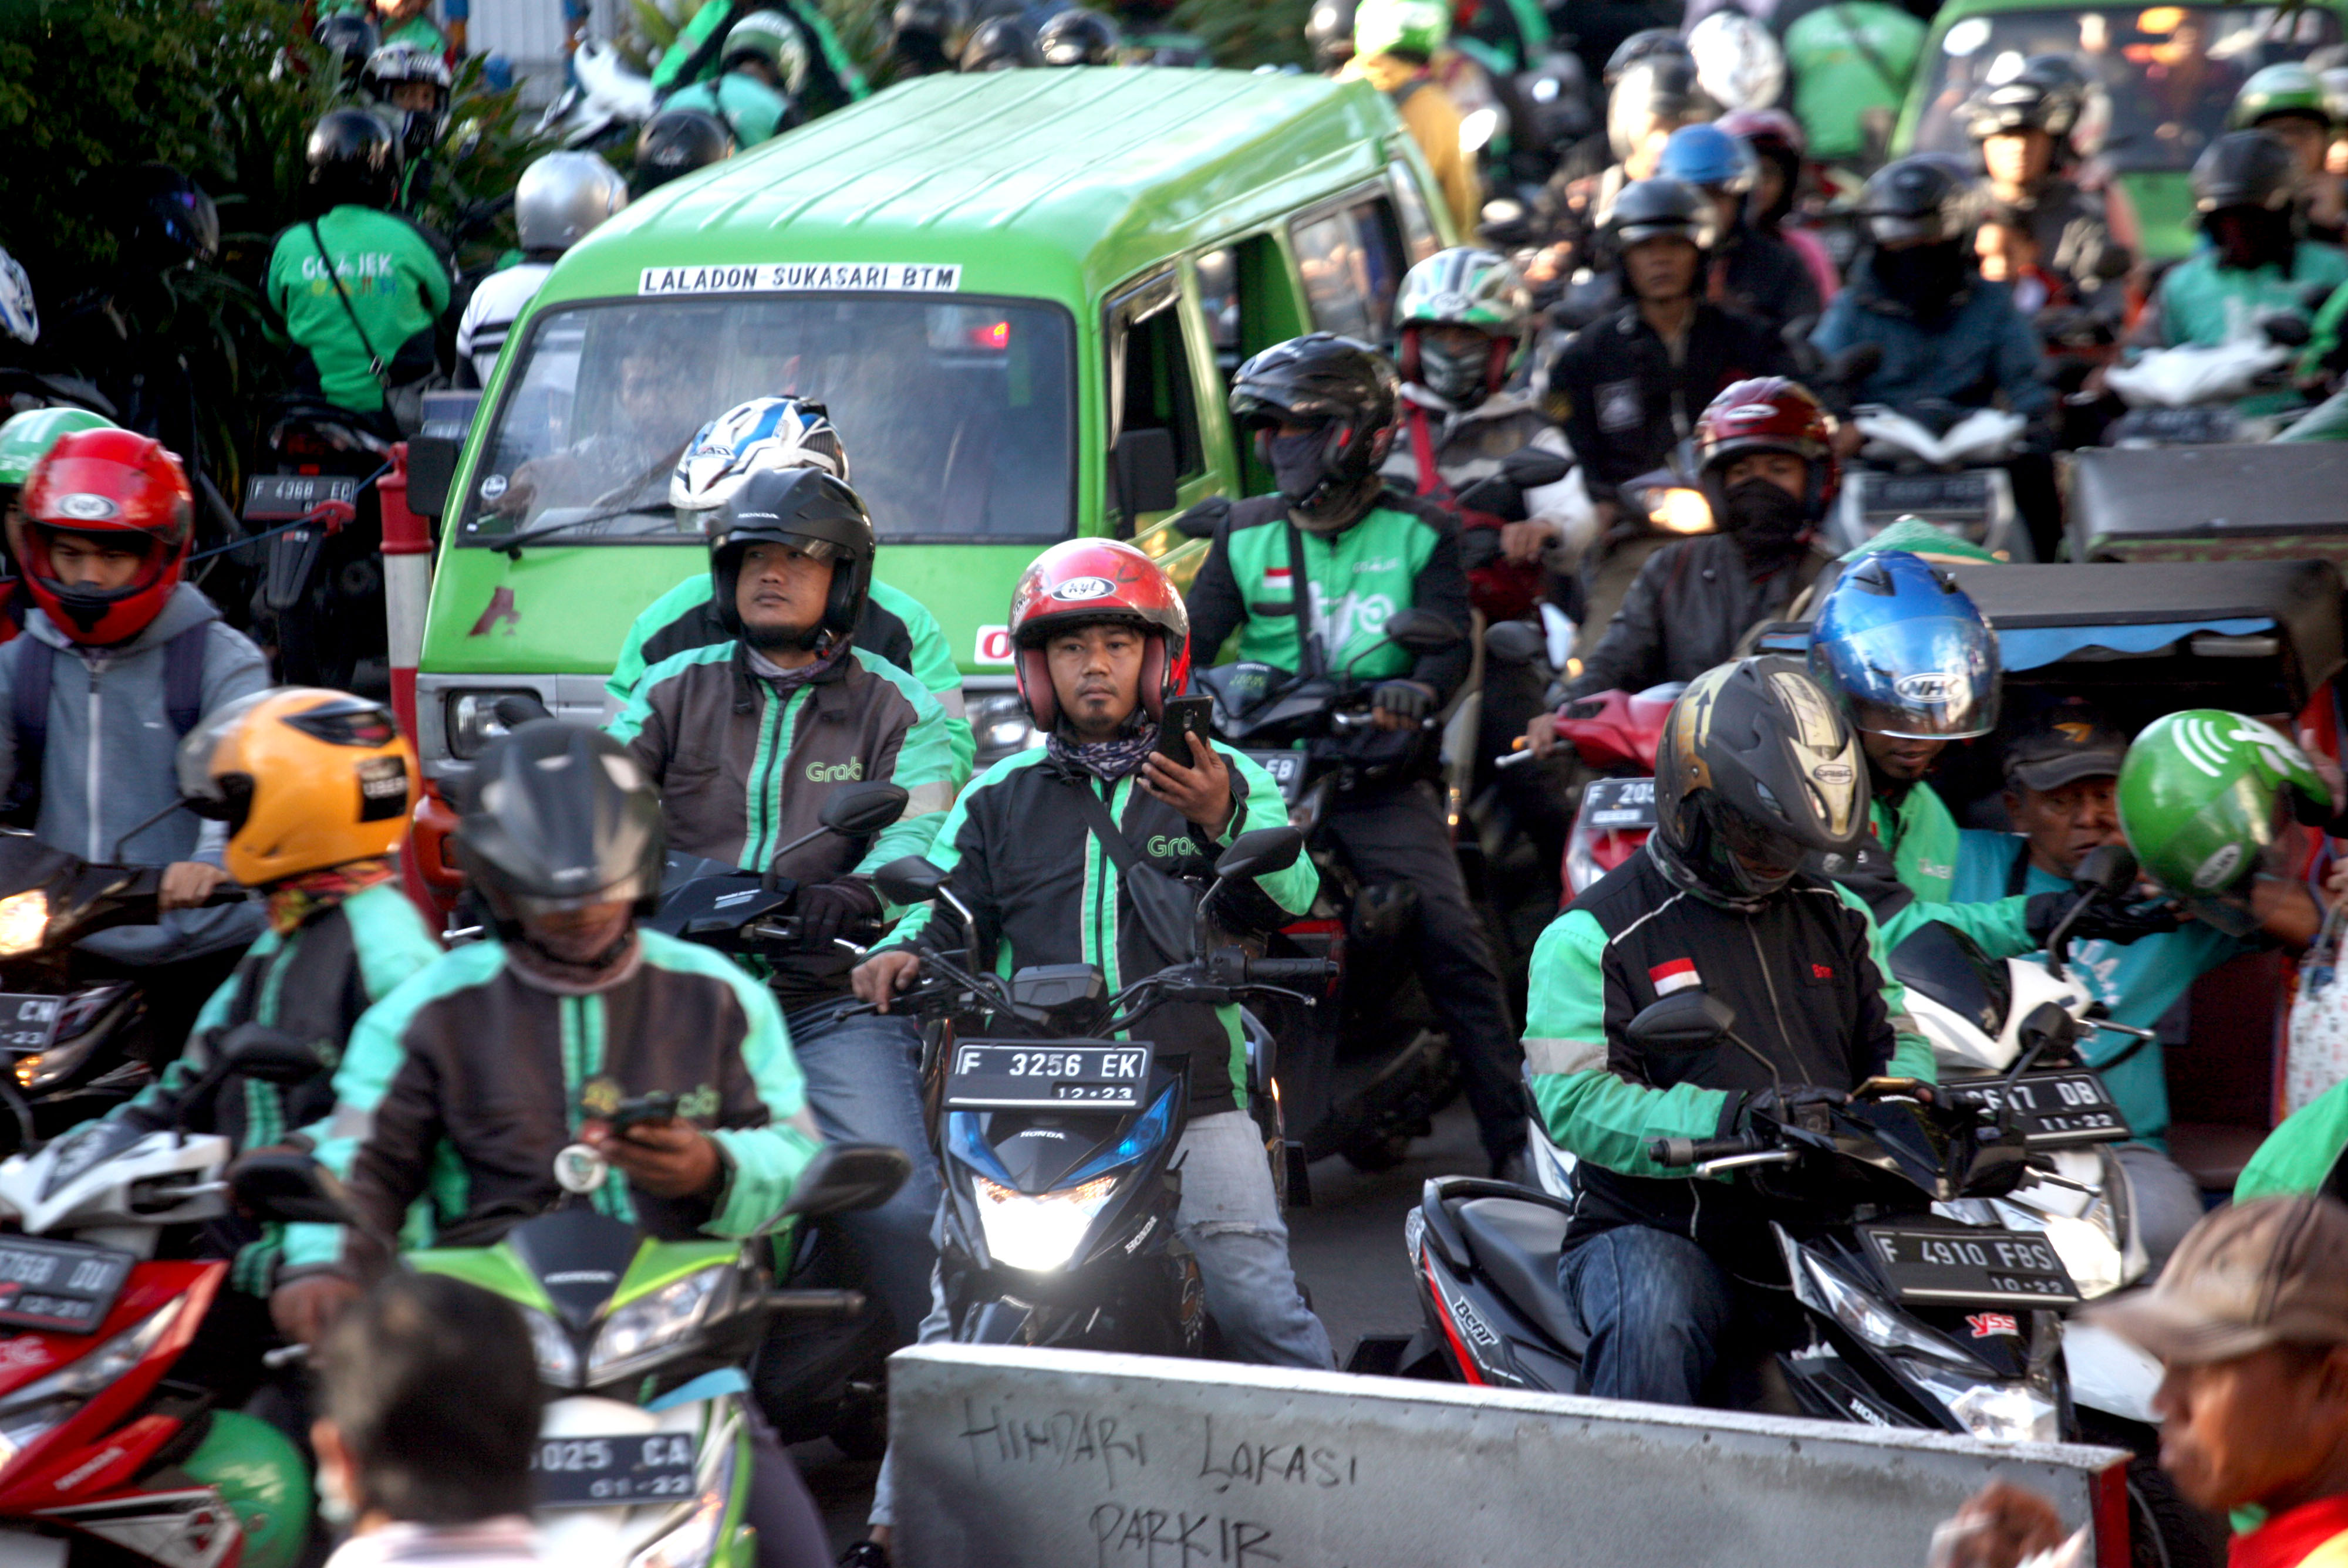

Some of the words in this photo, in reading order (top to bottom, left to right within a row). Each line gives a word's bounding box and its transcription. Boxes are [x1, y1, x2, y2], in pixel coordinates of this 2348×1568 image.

[645, 268, 757, 292] LALADON
[772, 266, 888, 288] SUKASARI
[902, 268, 954, 288] BTM
[255, 481, 264, 499] F
[805, 755, 862, 783] Grab
[1587, 785, 1605, 806] F
[960, 1052, 981, 1075] F
[1009, 1053, 1082, 1077] 3256
[1101, 1054, 1139, 1078] EK
[1020, 1130, 1066, 1140] HONDA
[1124, 1215, 1158, 1255] HONDA
[1879, 1238, 1898, 1263] F
[1922, 1241, 1988, 1266] 4910
[1995, 1242, 2053, 1270] FBS
[531, 1439, 613, 1471] 025
[959, 1397, 1146, 1491] HINDARI
[1198, 1414, 1355, 1491] LOKASI
[1089, 1503, 1283, 1568] PARKIR
